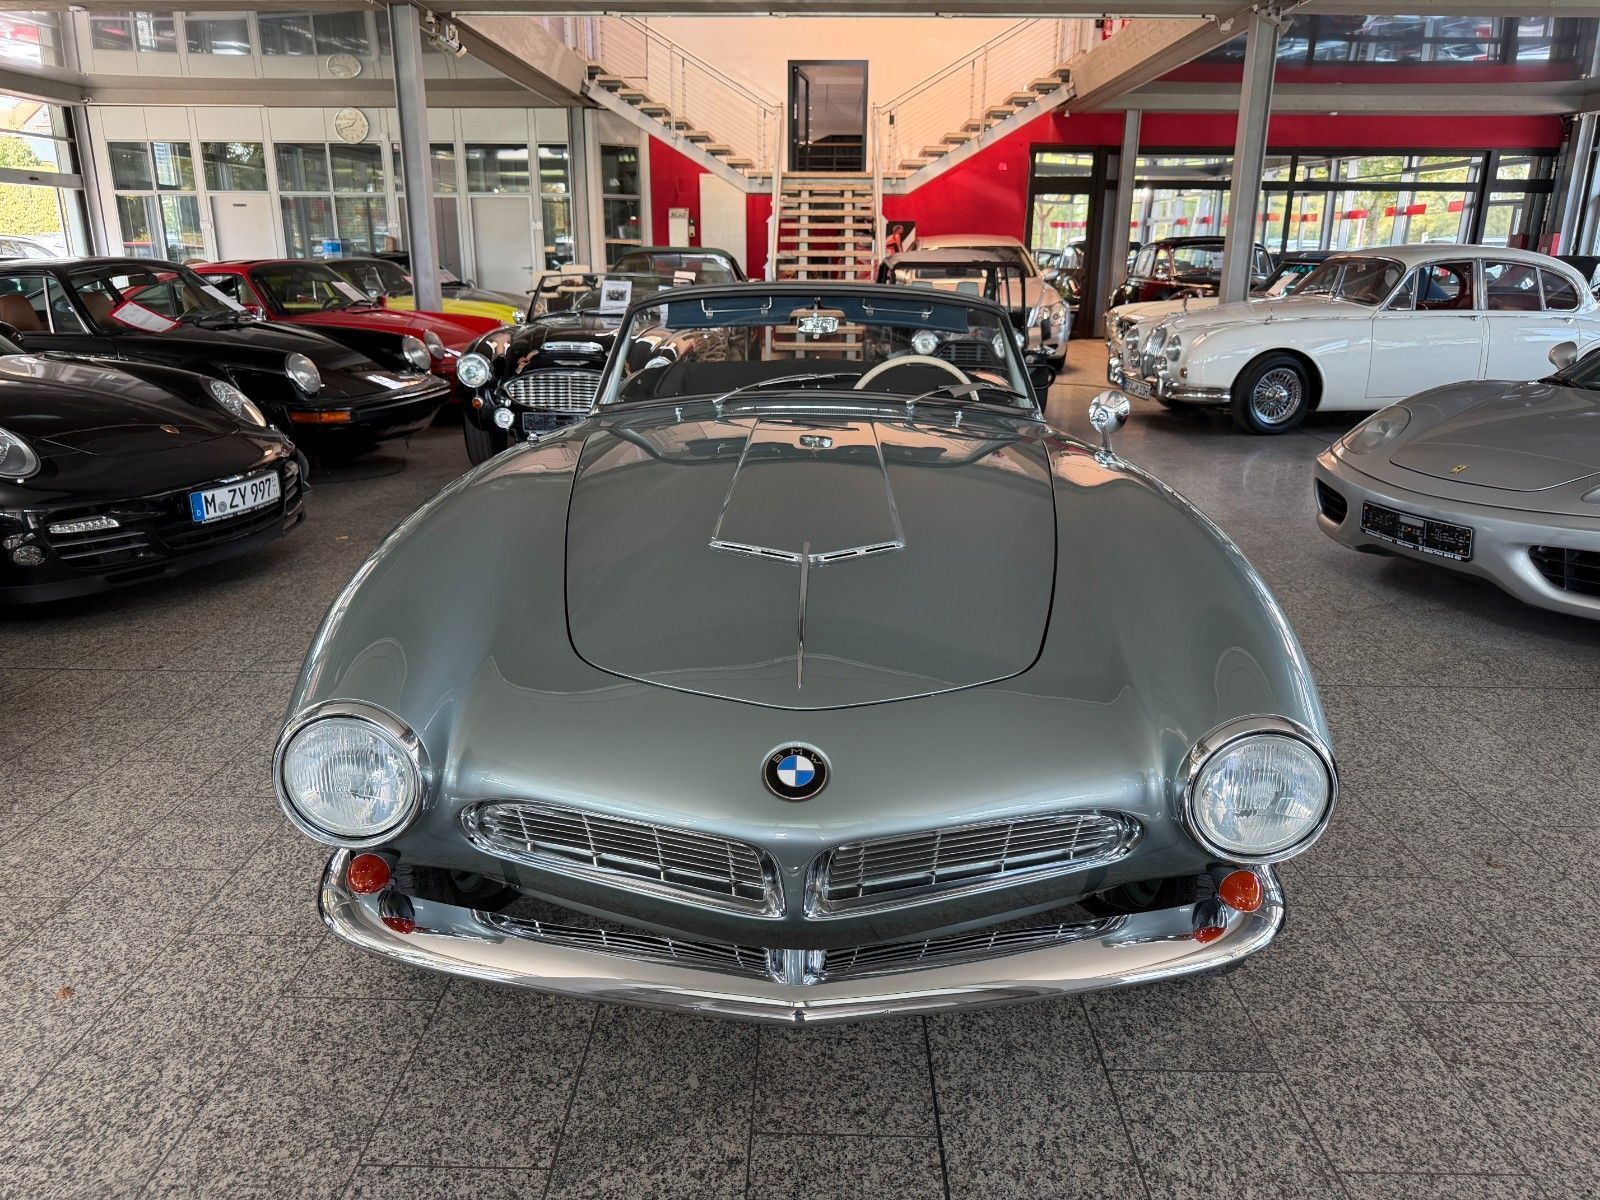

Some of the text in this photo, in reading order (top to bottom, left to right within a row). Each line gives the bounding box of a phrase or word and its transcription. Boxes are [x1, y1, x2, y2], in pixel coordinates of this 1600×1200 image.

[203, 493, 217, 515] M
[228, 485, 247, 509] ZY
[250, 478, 272, 502] 997
[772, 748, 823, 765] BMW
